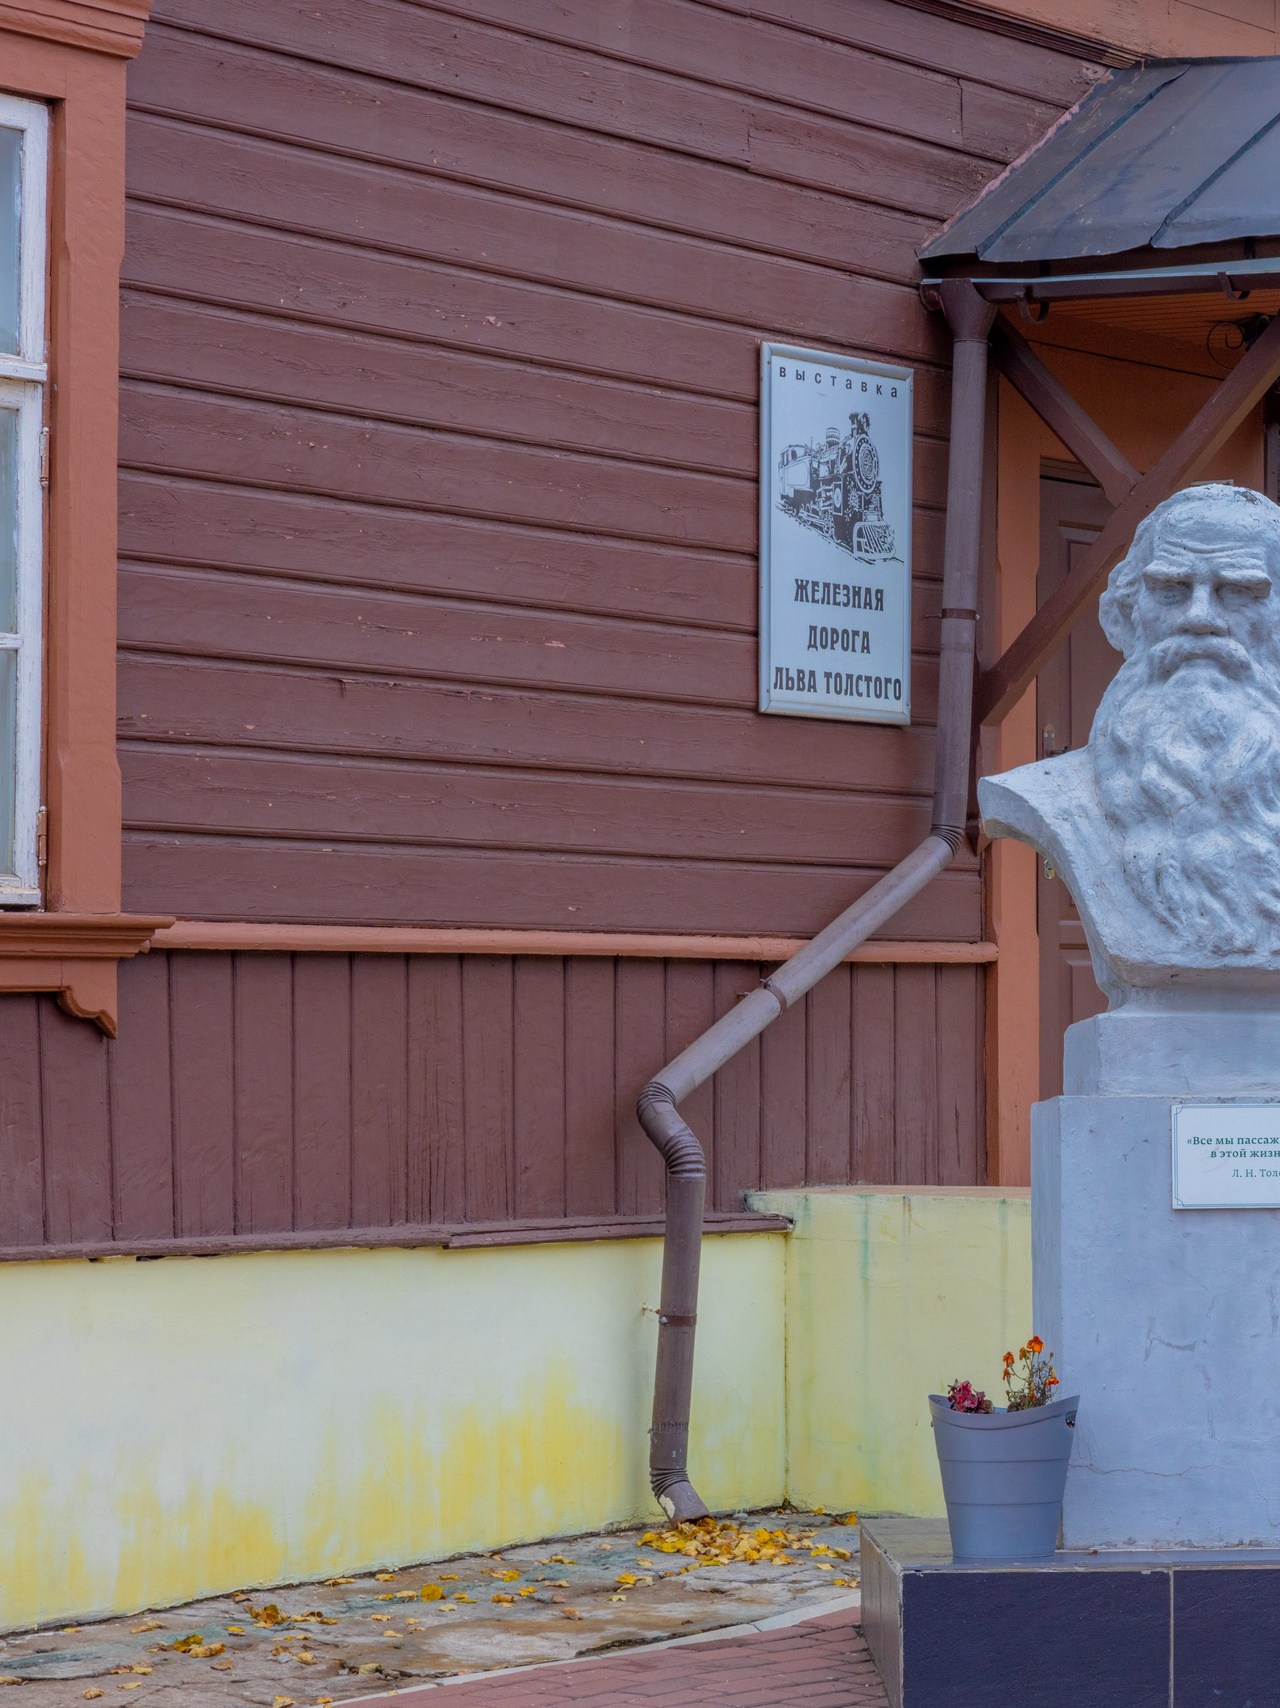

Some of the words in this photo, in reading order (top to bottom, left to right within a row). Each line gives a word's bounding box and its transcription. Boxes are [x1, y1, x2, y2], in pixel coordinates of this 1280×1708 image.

[793, 578, 885, 612] ЖЕЛЕЗНАЯ
[806, 624, 871, 655] ДОРОГА
[773, 666, 818, 694] ЛЬВА
[823, 671, 902, 701] ТОЛСТОГО
[1186, 1136, 1213, 1145] «Все
[1215, 1137, 1234, 1145] мы
[1210, 1150, 1217, 1158] в
[1219, 1148, 1247, 1158] этой
[1231, 1169, 1243, 1178] Л.
[1245, 1169, 1257, 1178] Н.
